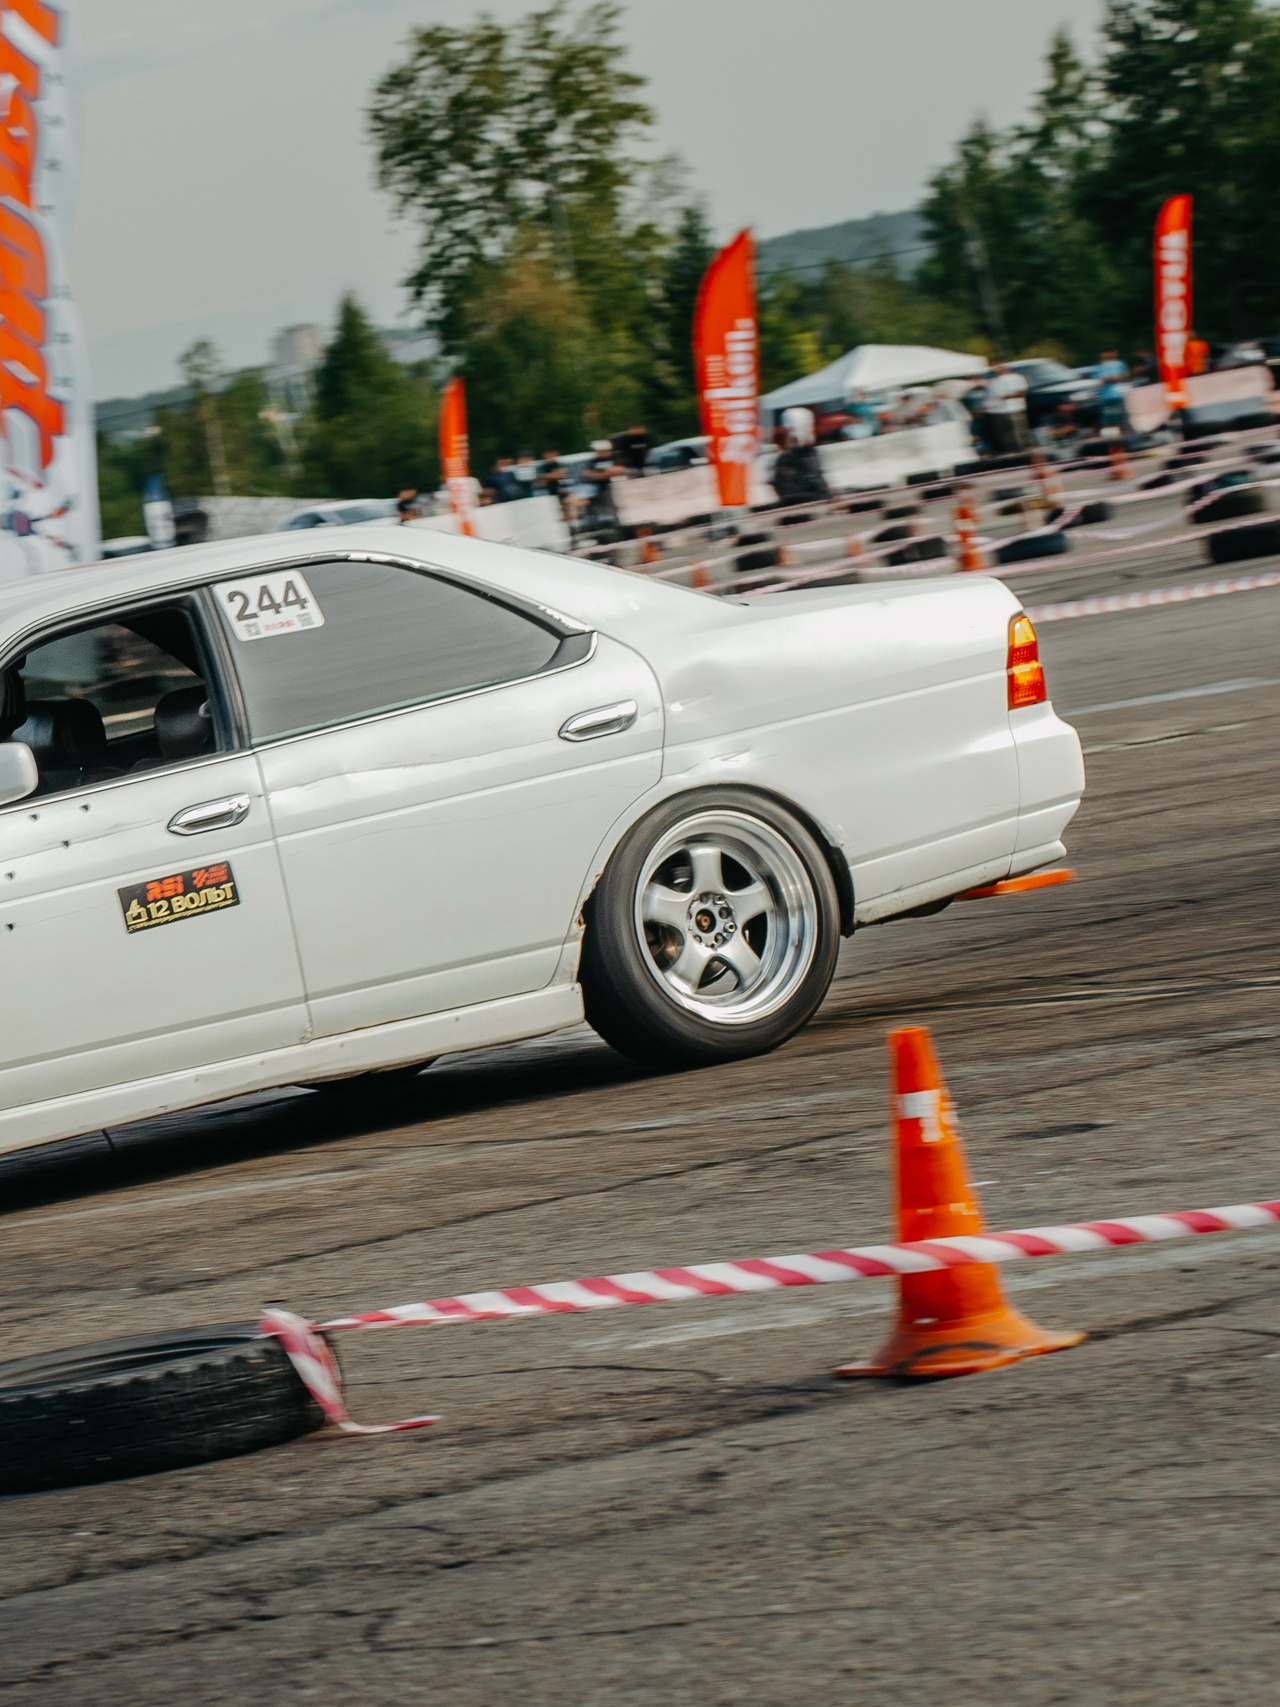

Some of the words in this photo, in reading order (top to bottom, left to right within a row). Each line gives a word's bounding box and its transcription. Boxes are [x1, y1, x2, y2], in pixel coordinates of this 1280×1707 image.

[227, 580, 309, 621] 244
[147, 900, 171, 920] 12
[171, 882, 235, 914] ВОЛЬТ
